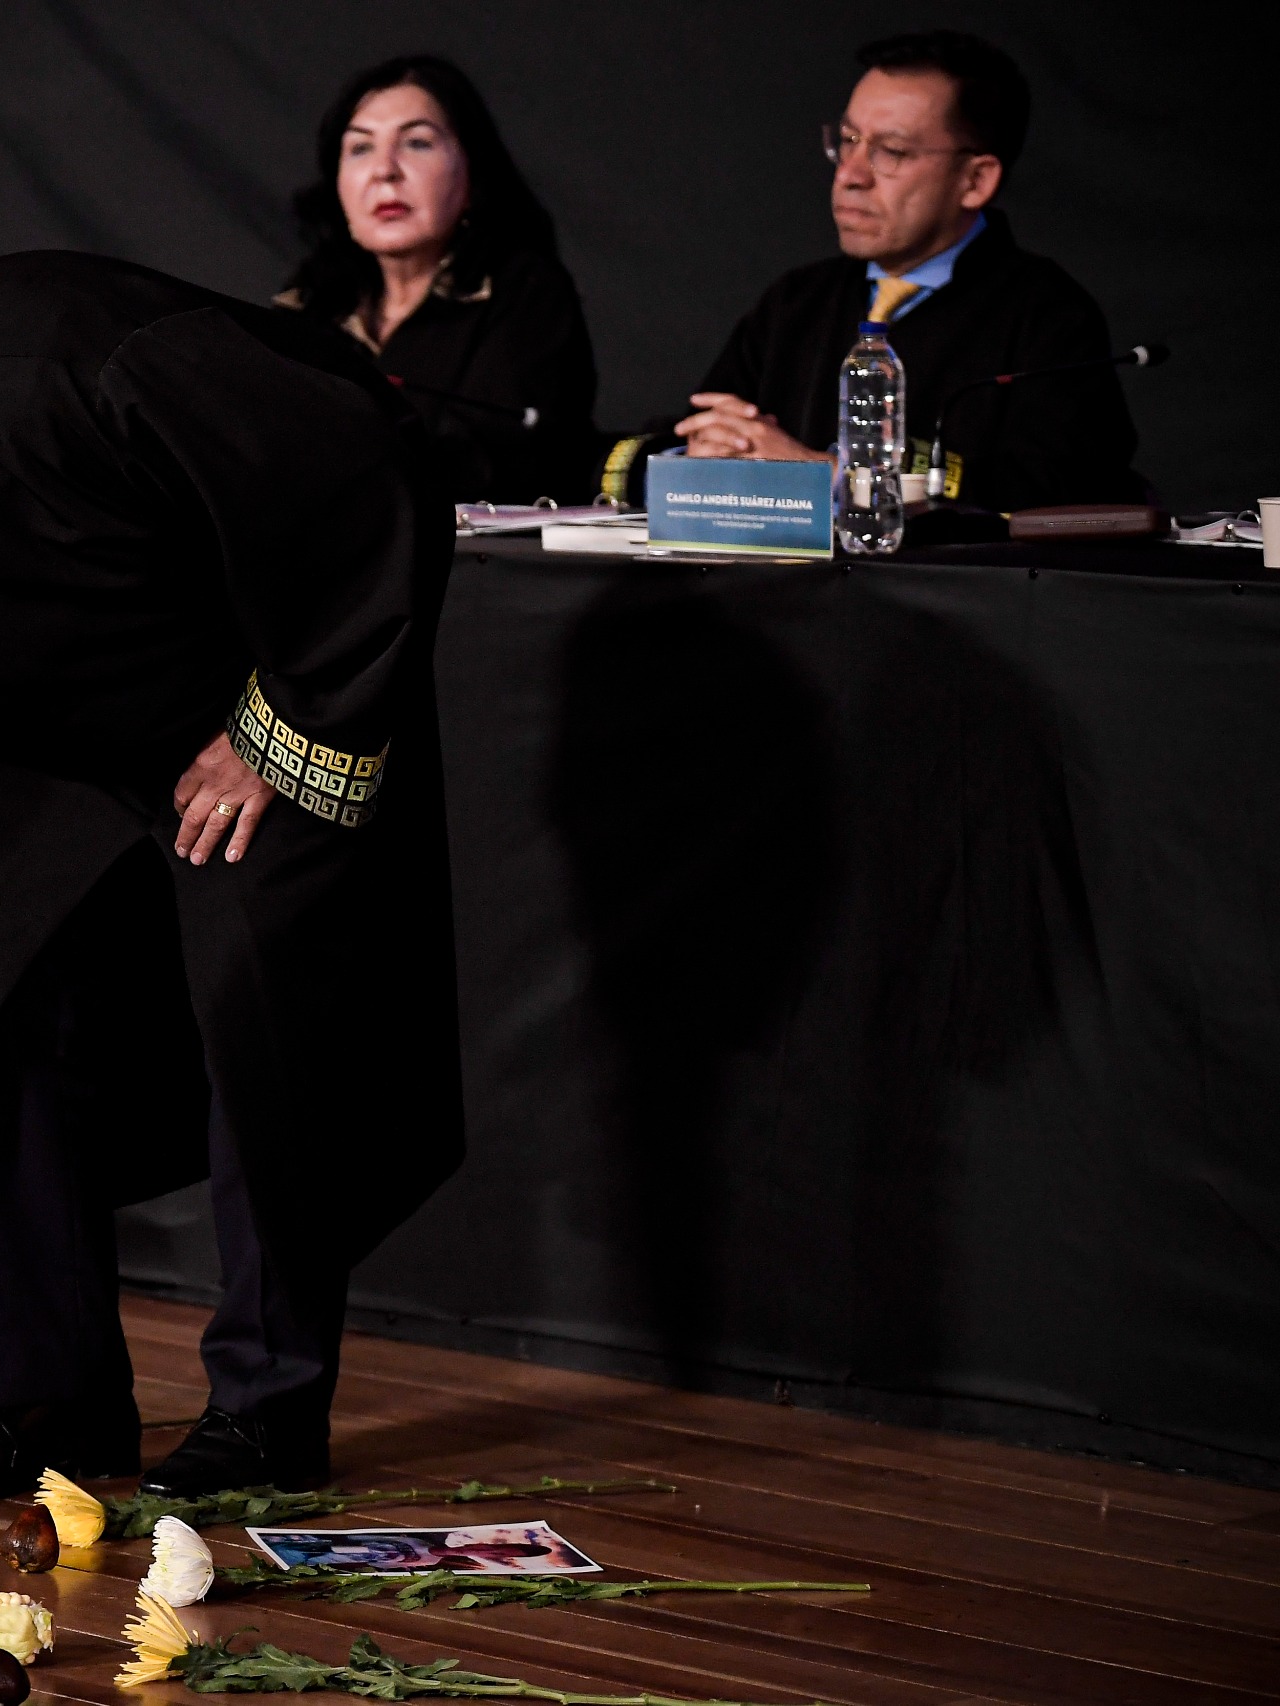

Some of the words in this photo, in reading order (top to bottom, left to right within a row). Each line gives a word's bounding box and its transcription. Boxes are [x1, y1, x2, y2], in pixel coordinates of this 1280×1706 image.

[666, 492, 701, 504] CAMILO
[702, 493, 738, 506] ANDRÉS
[740, 494, 774, 508] SUÁREZ
[774, 498, 813, 510] ALDANA
